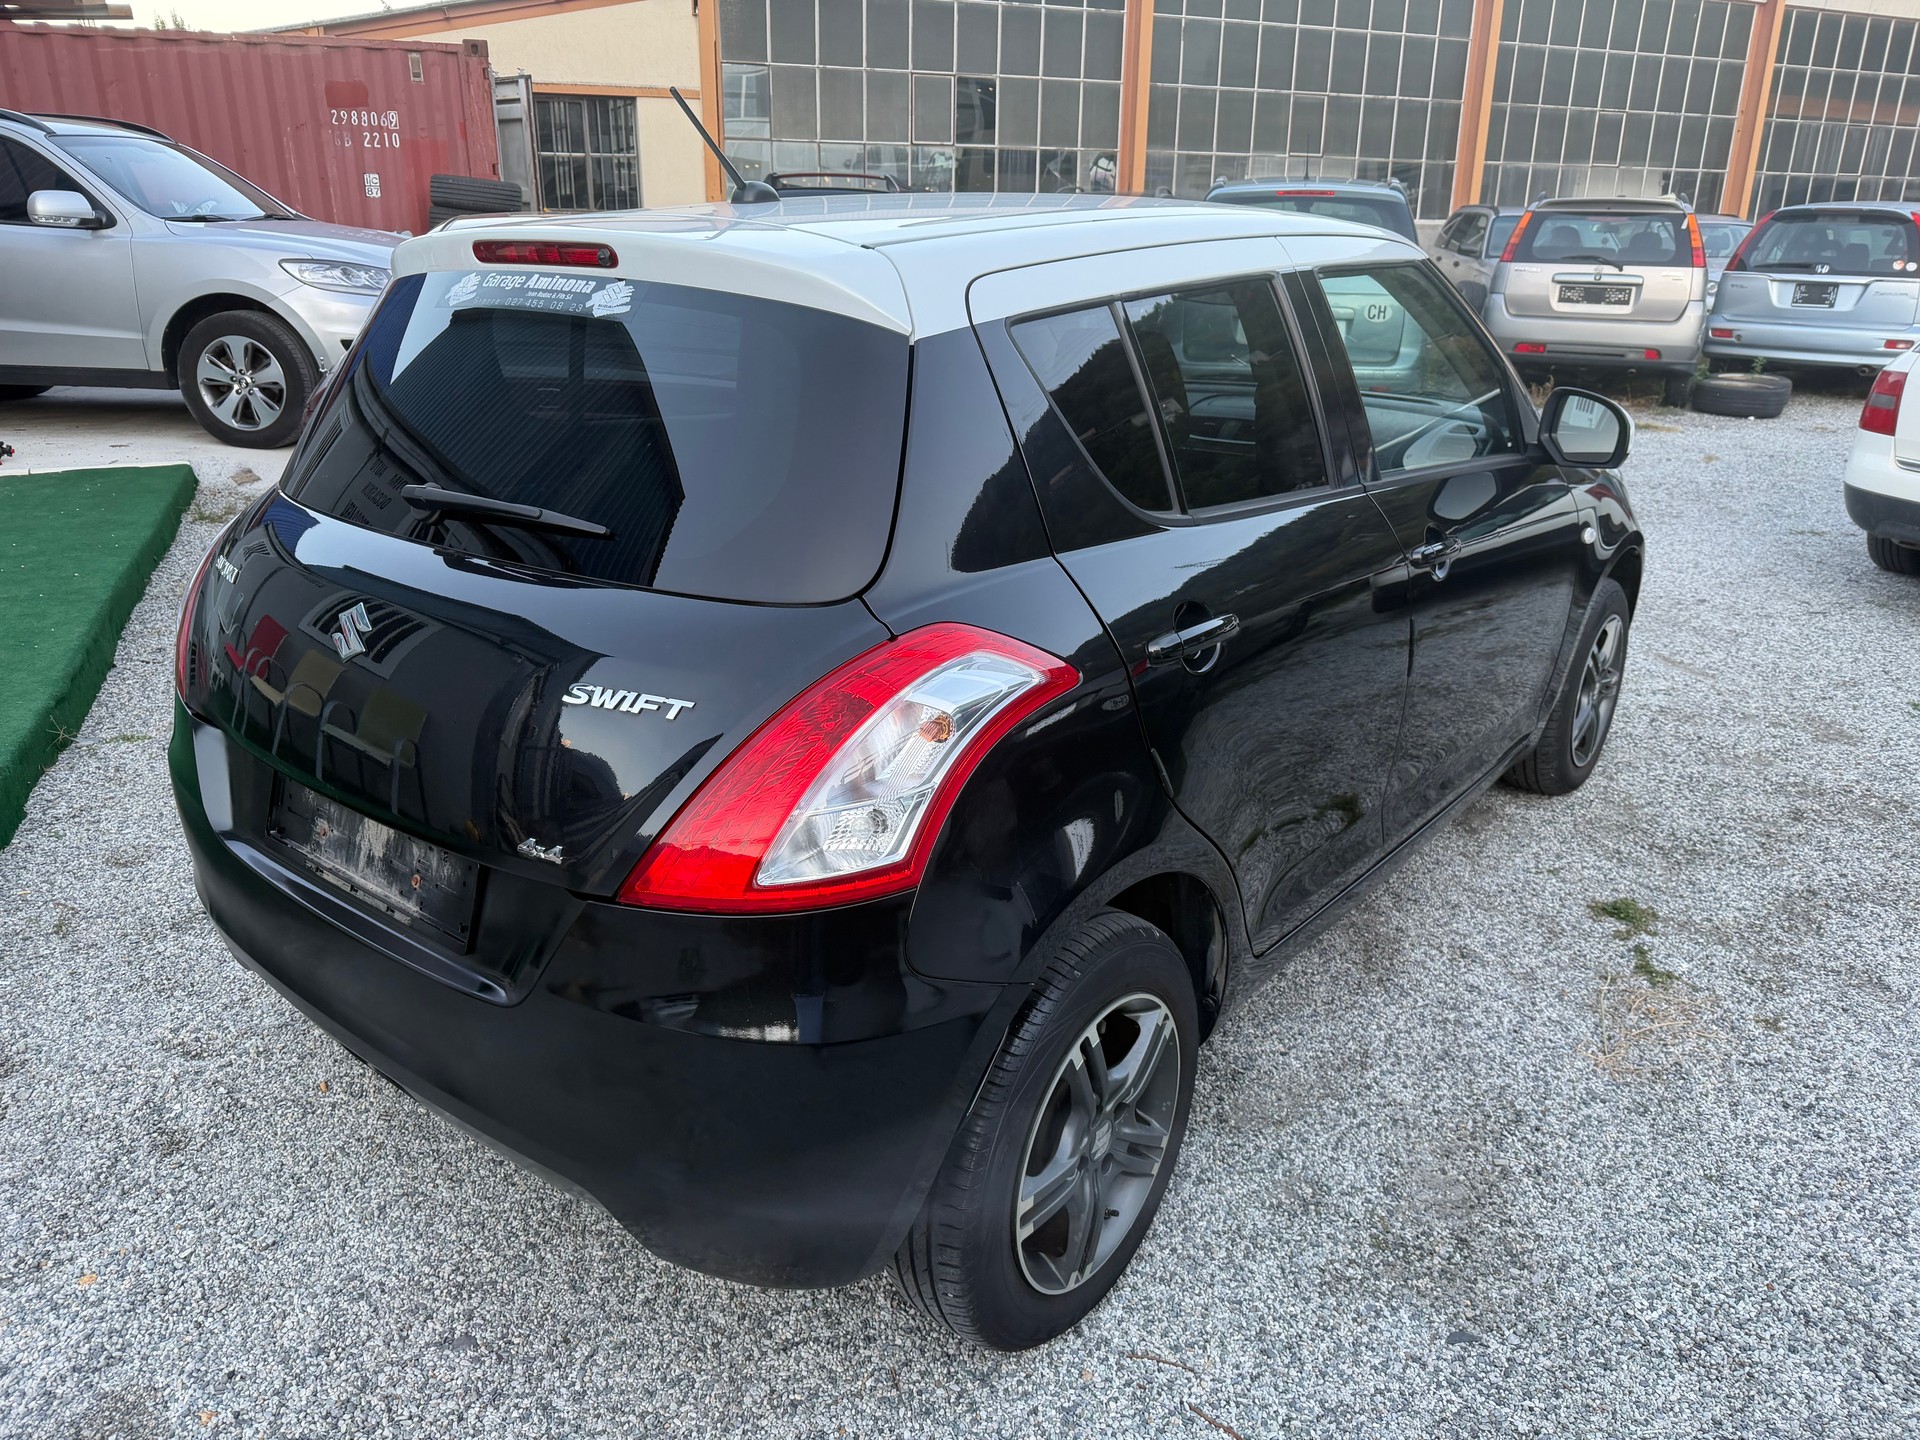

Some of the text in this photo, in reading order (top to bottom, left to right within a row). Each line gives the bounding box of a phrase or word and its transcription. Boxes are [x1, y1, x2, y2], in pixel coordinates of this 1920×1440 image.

[363, 131, 400, 148] 2210
[366, 187, 380, 196] 87
[482, 272, 597, 294] Garage Aminona
[505, 297, 523, 306] 027
[525, 299, 545, 308] 455
[549, 301, 564, 310] 08
[569, 303, 584, 313] 23
[1367, 304, 1387, 320] CH
[562, 682, 696, 721] SWIFT
